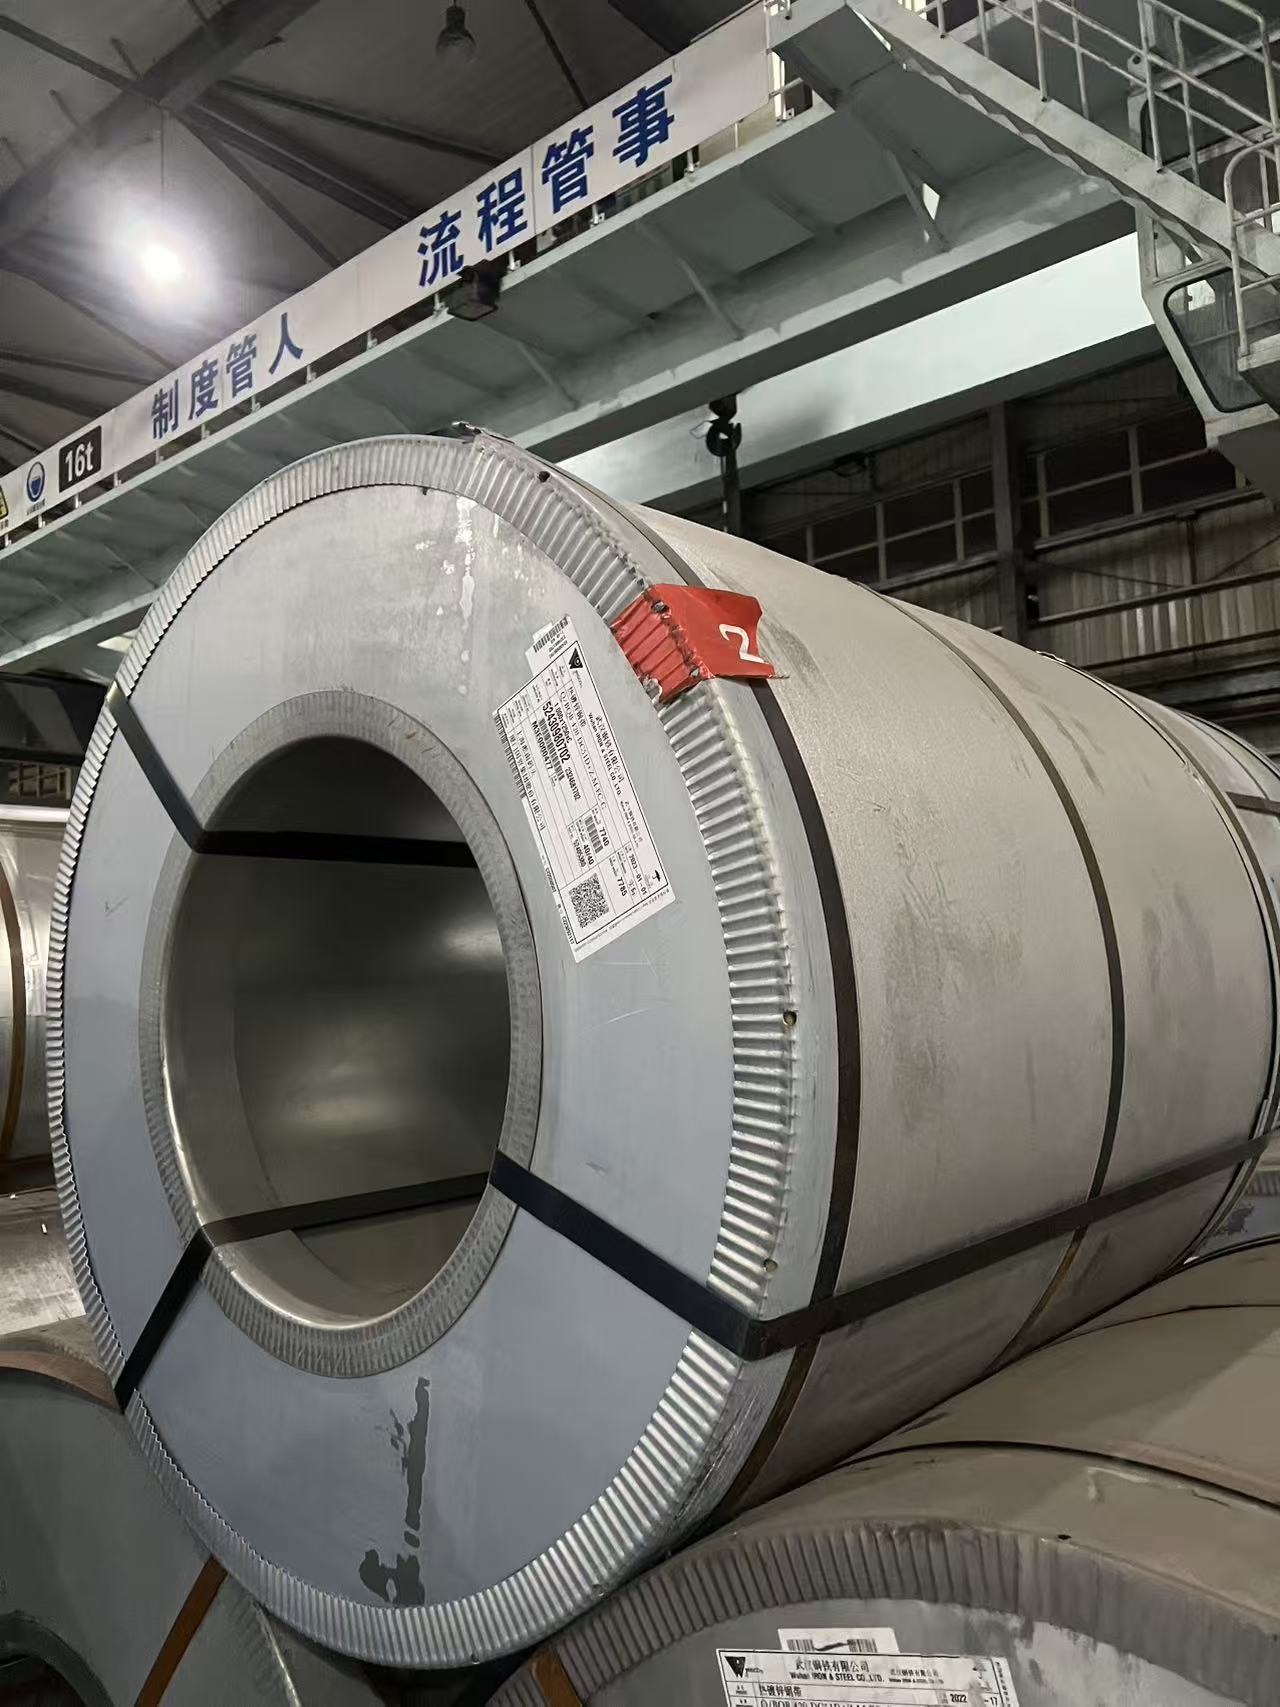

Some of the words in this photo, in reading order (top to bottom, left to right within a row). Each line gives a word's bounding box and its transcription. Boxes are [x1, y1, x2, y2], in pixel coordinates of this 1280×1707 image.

[151, 312, 303, 439] 制度管人
[417, 74, 675, 287] 流程管事
[65, 440, 94, 483] 16t
[719, 624, 764, 664] 2
[541, 699, 571, 764] 52430980702
[598, 826, 610, 847] 7740
[582, 841, 595, 866] 40/40
[615, 875, 628, 897] 7785
[835, 1673, 855, 1682] STEEL
[950, 1694, 968, 1703] 2022
